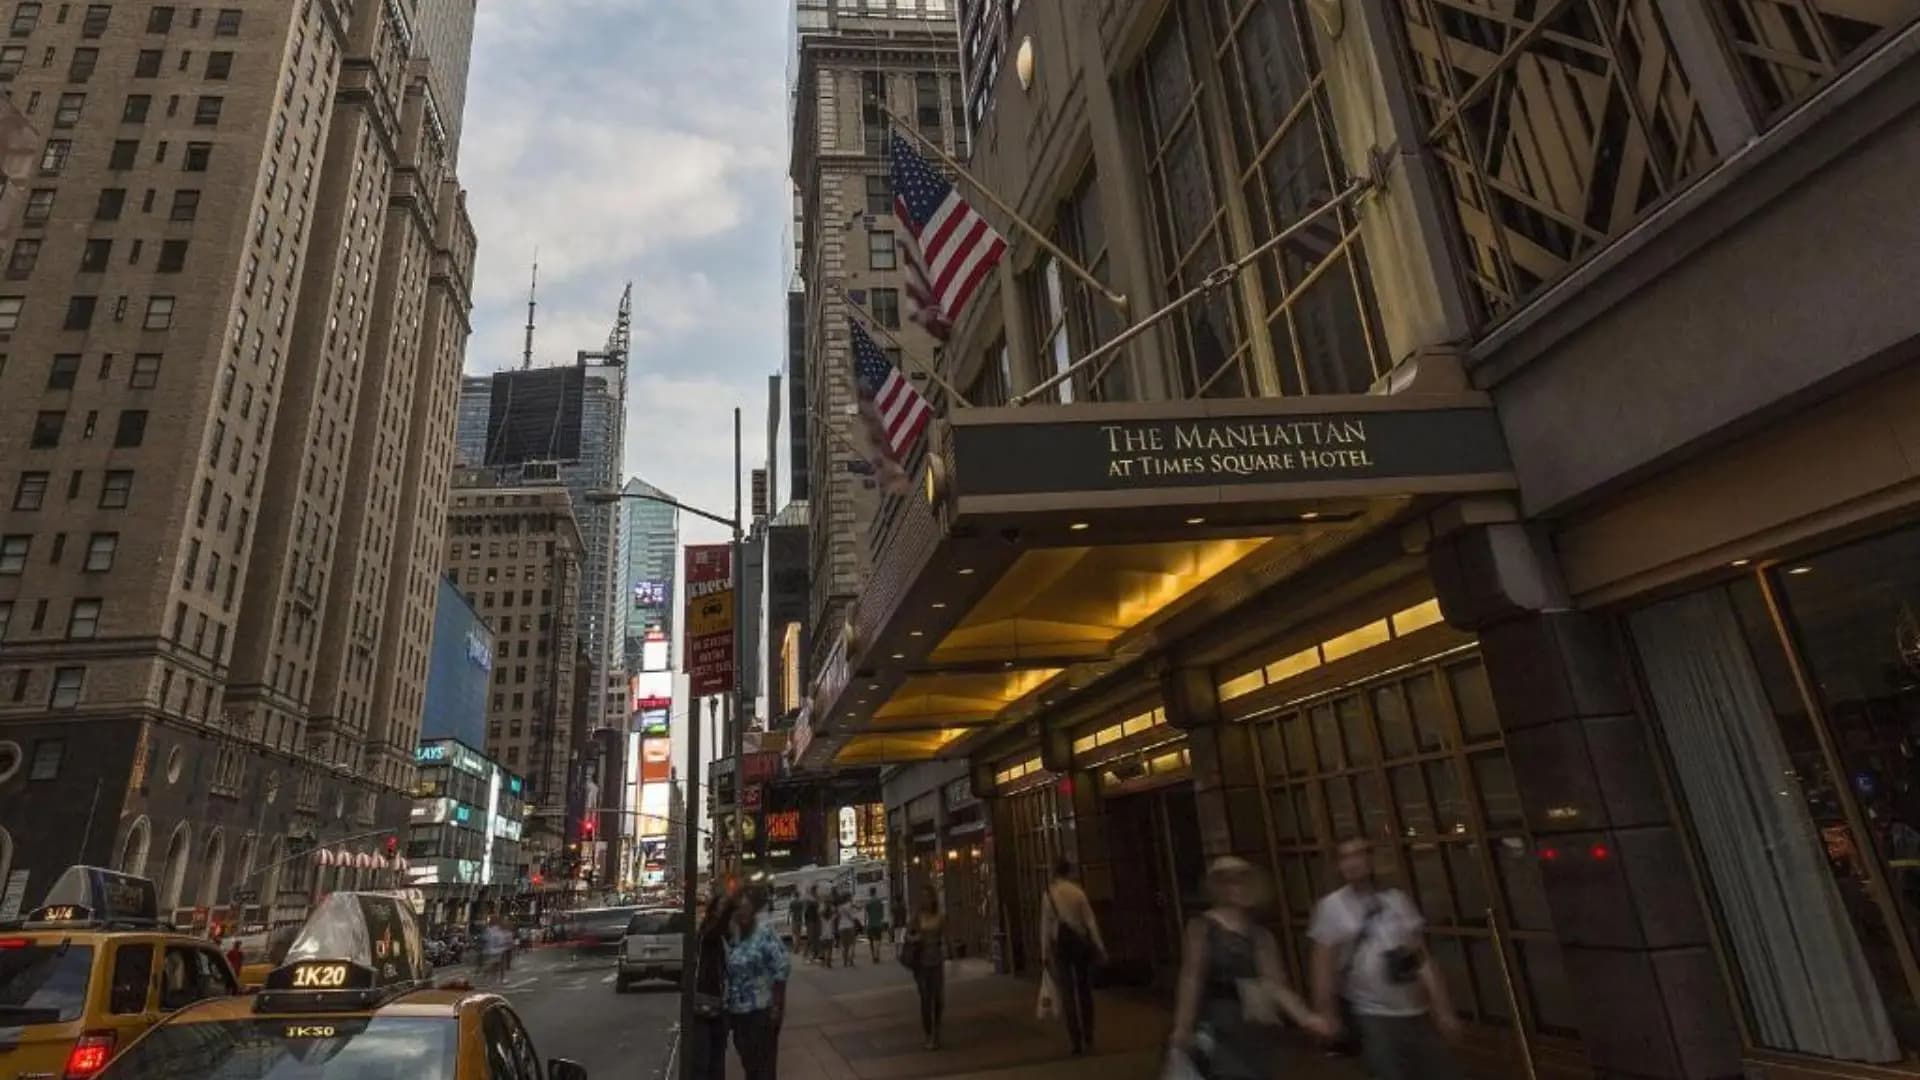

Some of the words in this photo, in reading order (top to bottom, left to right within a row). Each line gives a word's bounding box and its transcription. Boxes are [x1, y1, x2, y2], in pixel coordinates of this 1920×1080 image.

[1101, 425, 1163, 452] THE
[1174, 420, 1367, 450] MANHATTAN
[1109, 459, 1133, 476] AT
[1136, 455, 1205, 475] TIMES
[1211, 451, 1295, 475] SQUARE
[1300, 449, 1374, 469] HOTEL
[293, 965, 347, 987] 1K20
